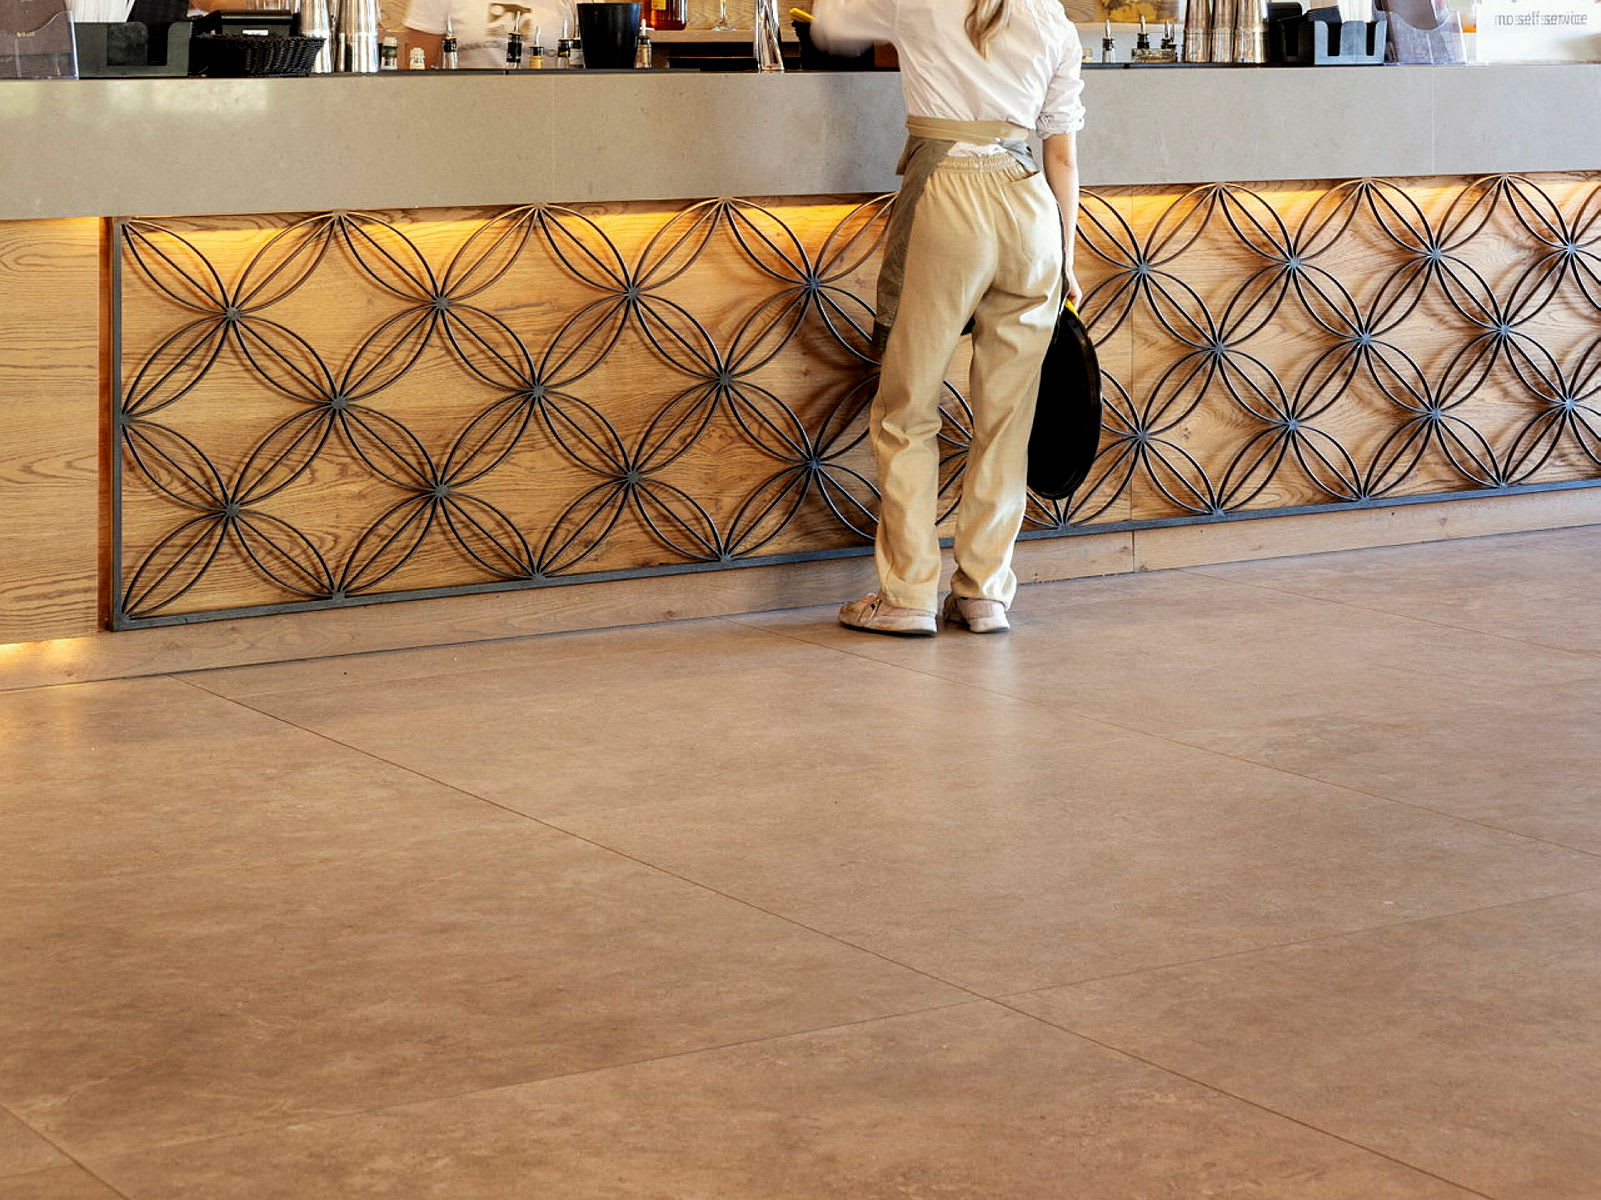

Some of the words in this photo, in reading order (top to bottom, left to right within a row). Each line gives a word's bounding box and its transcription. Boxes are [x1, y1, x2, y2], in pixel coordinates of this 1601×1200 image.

[1495, 13, 1514, 26] no
[1515, 10, 1541, 26] self
[1541, 11, 1588, 26] service
